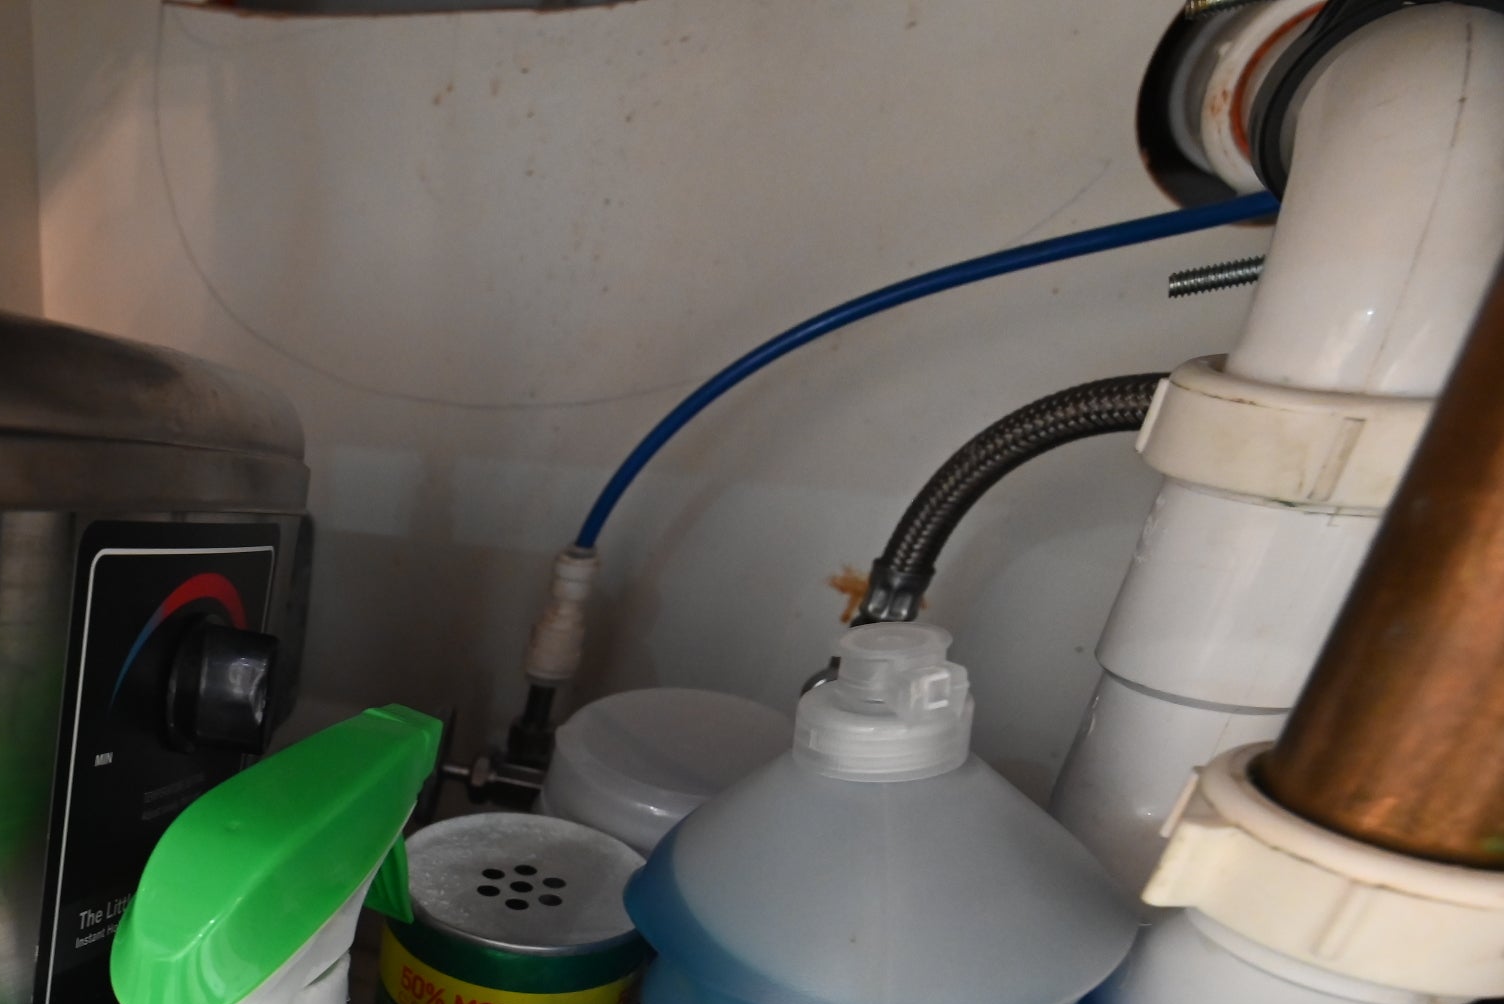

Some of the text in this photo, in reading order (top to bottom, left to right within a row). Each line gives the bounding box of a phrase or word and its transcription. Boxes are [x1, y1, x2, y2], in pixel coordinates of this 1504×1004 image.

[94, 751, 114, 767] MIN
[79, 892, 131, 930] The Littl
[75, 928, 106, 949] Instant
